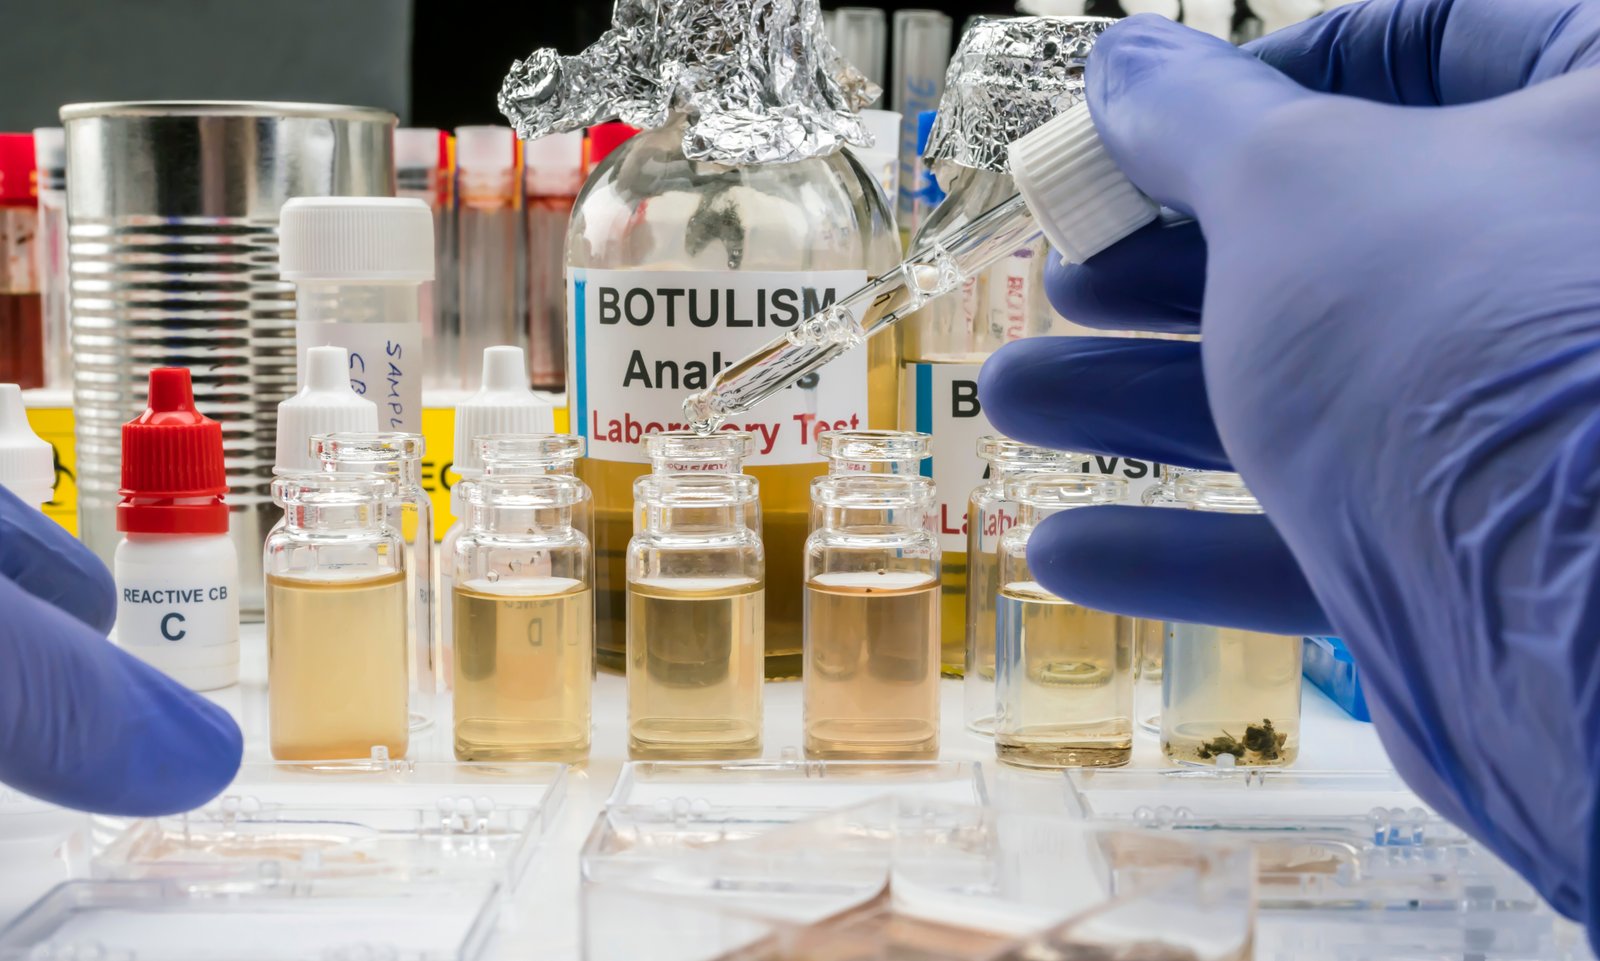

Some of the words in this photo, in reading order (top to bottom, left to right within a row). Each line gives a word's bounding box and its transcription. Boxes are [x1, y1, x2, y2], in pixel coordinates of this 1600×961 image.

[599, 286, 836, 328] BOTULISM
[123, 588, 204, 604] REACTIVE
[208, 586, 228, 601] CB
[160, 612, 186, 641] C
